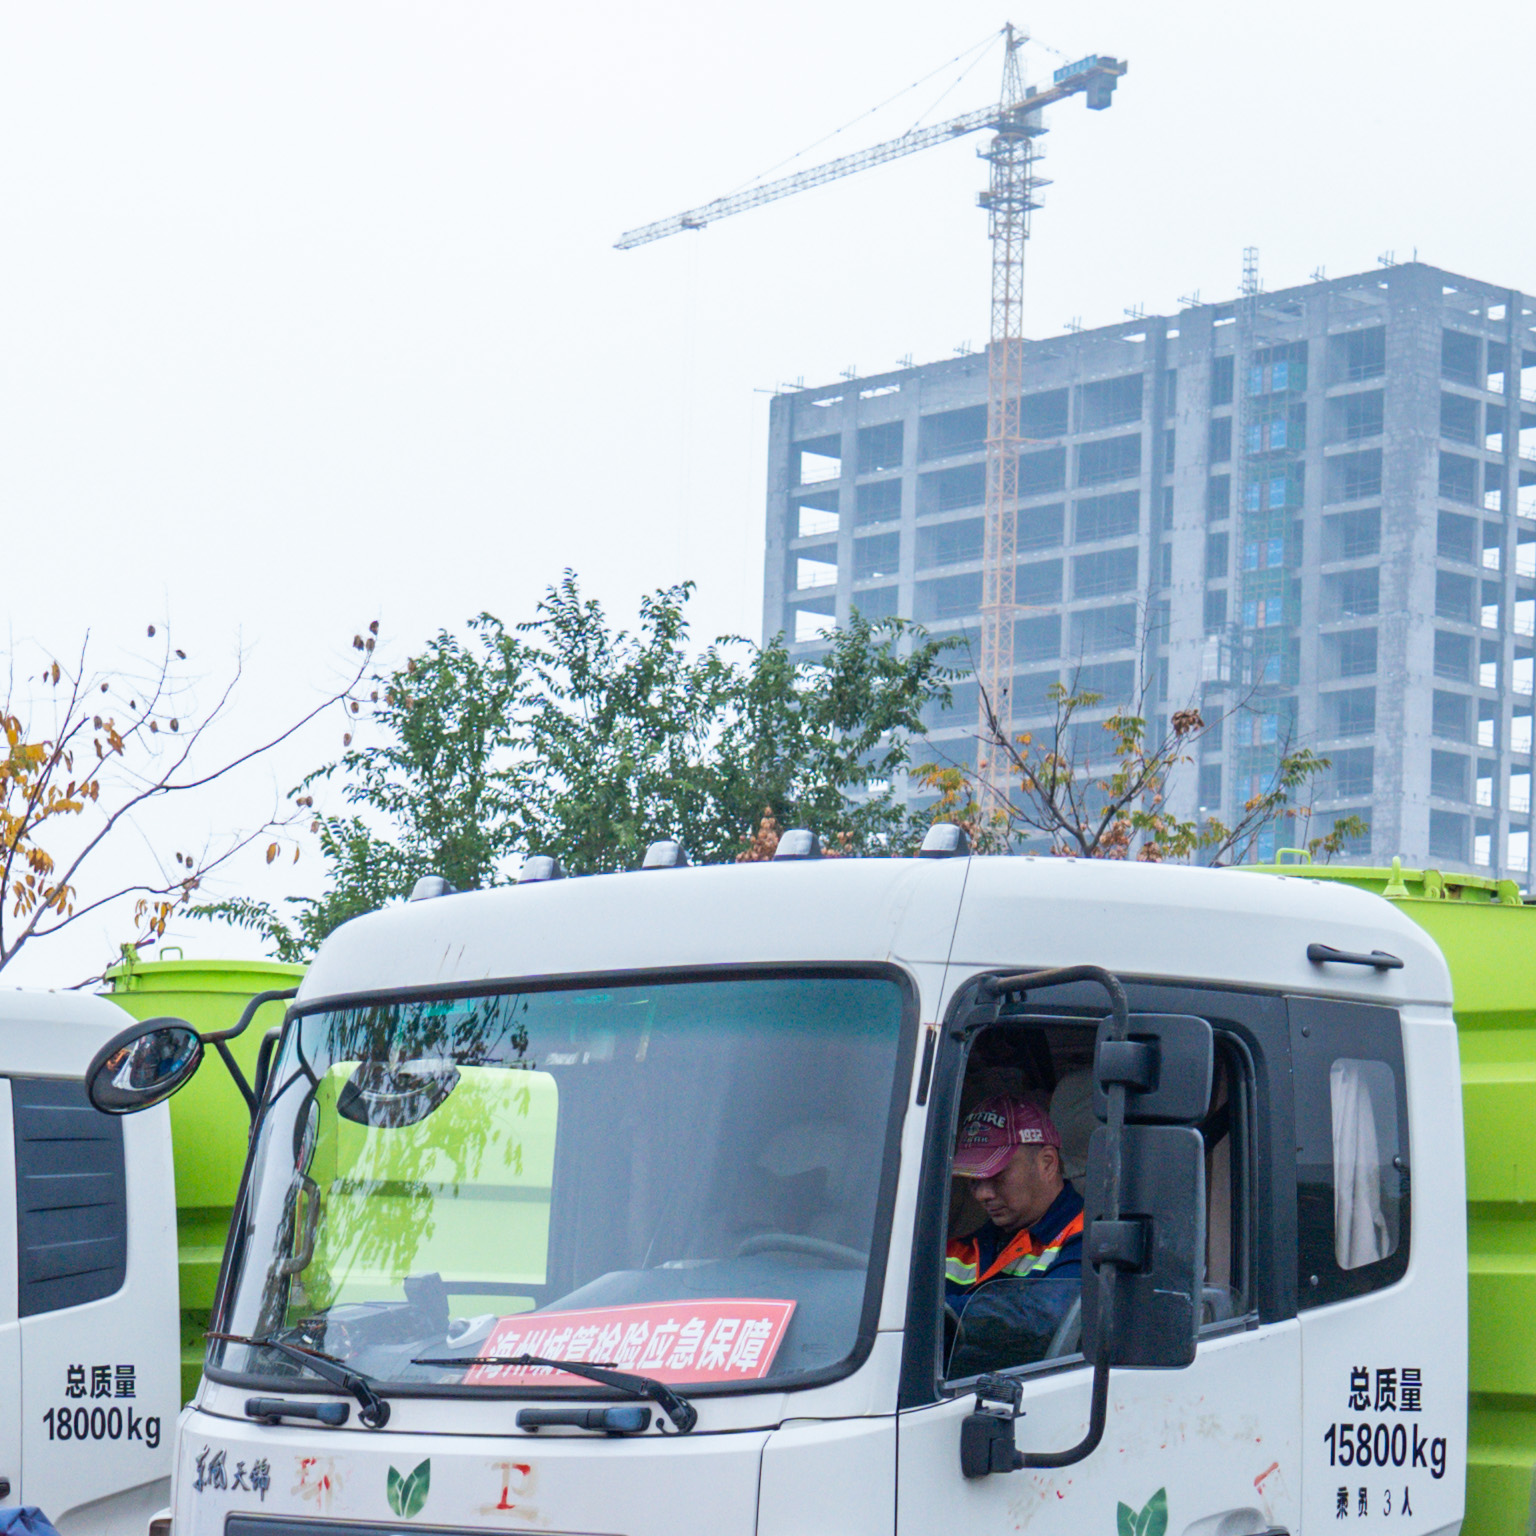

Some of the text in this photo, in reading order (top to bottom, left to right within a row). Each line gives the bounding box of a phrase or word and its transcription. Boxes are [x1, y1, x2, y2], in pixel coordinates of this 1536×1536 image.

[64, 1364, 137, 1399] 总质量
[1348, 1366, 1423, 1412] 总质量
